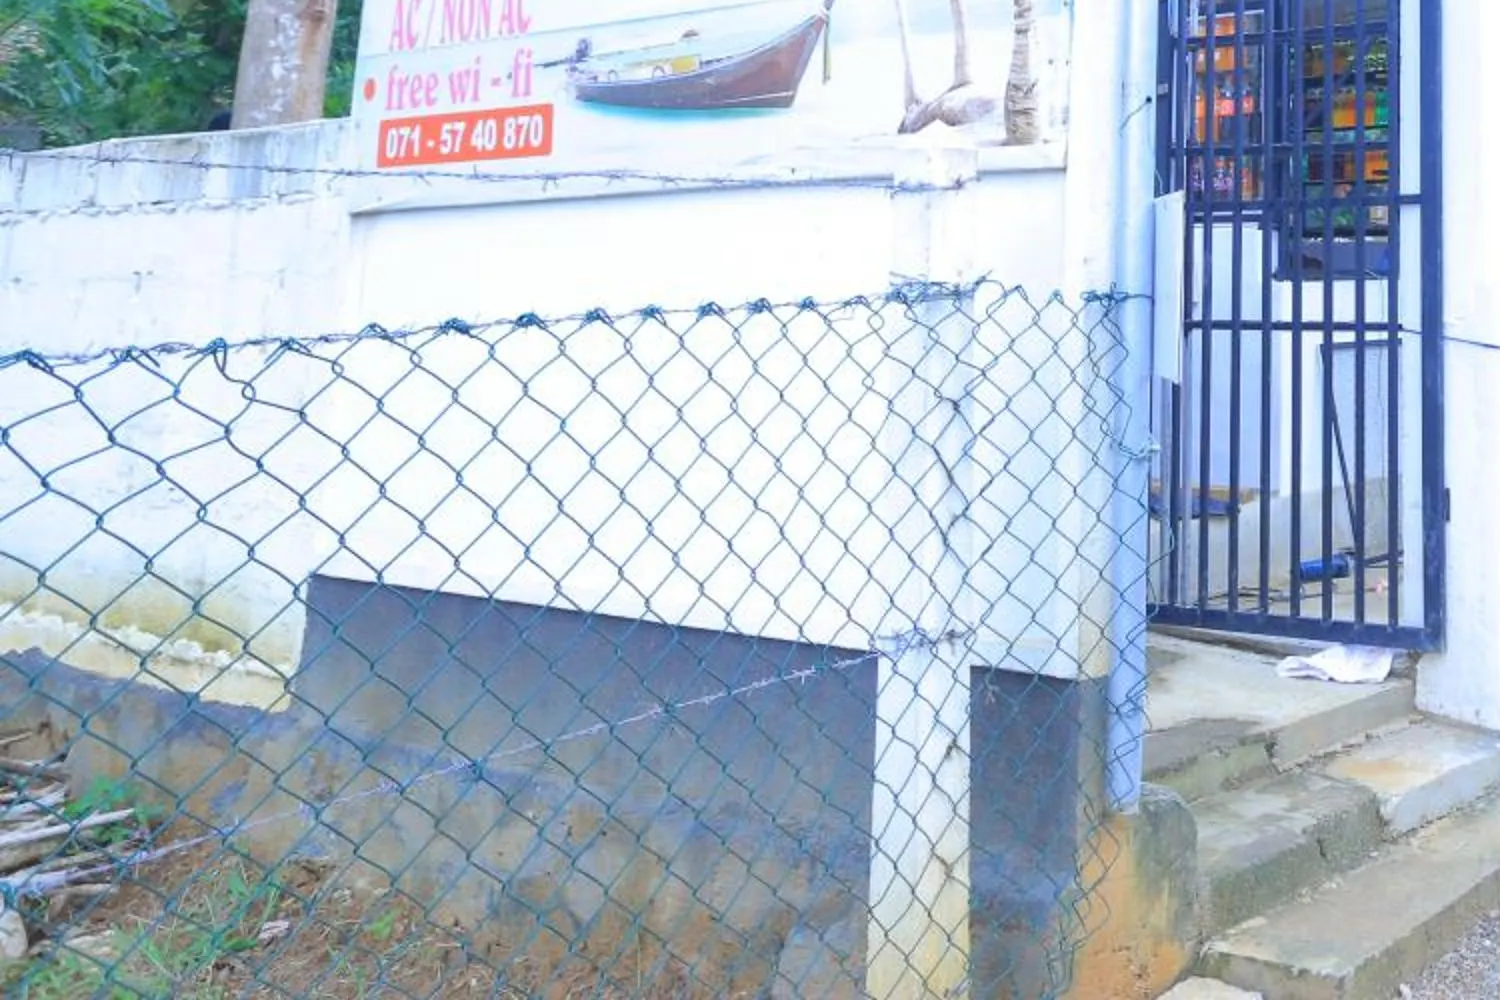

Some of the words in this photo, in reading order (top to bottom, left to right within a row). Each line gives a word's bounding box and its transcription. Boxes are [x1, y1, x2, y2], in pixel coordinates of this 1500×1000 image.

[385, 64, 439, 111] free
[448, 56, 481, 104] wi
[511, 48, 534, 98] fi
[385, 125, 421, 160] 071
[439, 121, 465, 155] 57
[470, 119, 497, 151] 40
[503, 115, 544, 149] 870
